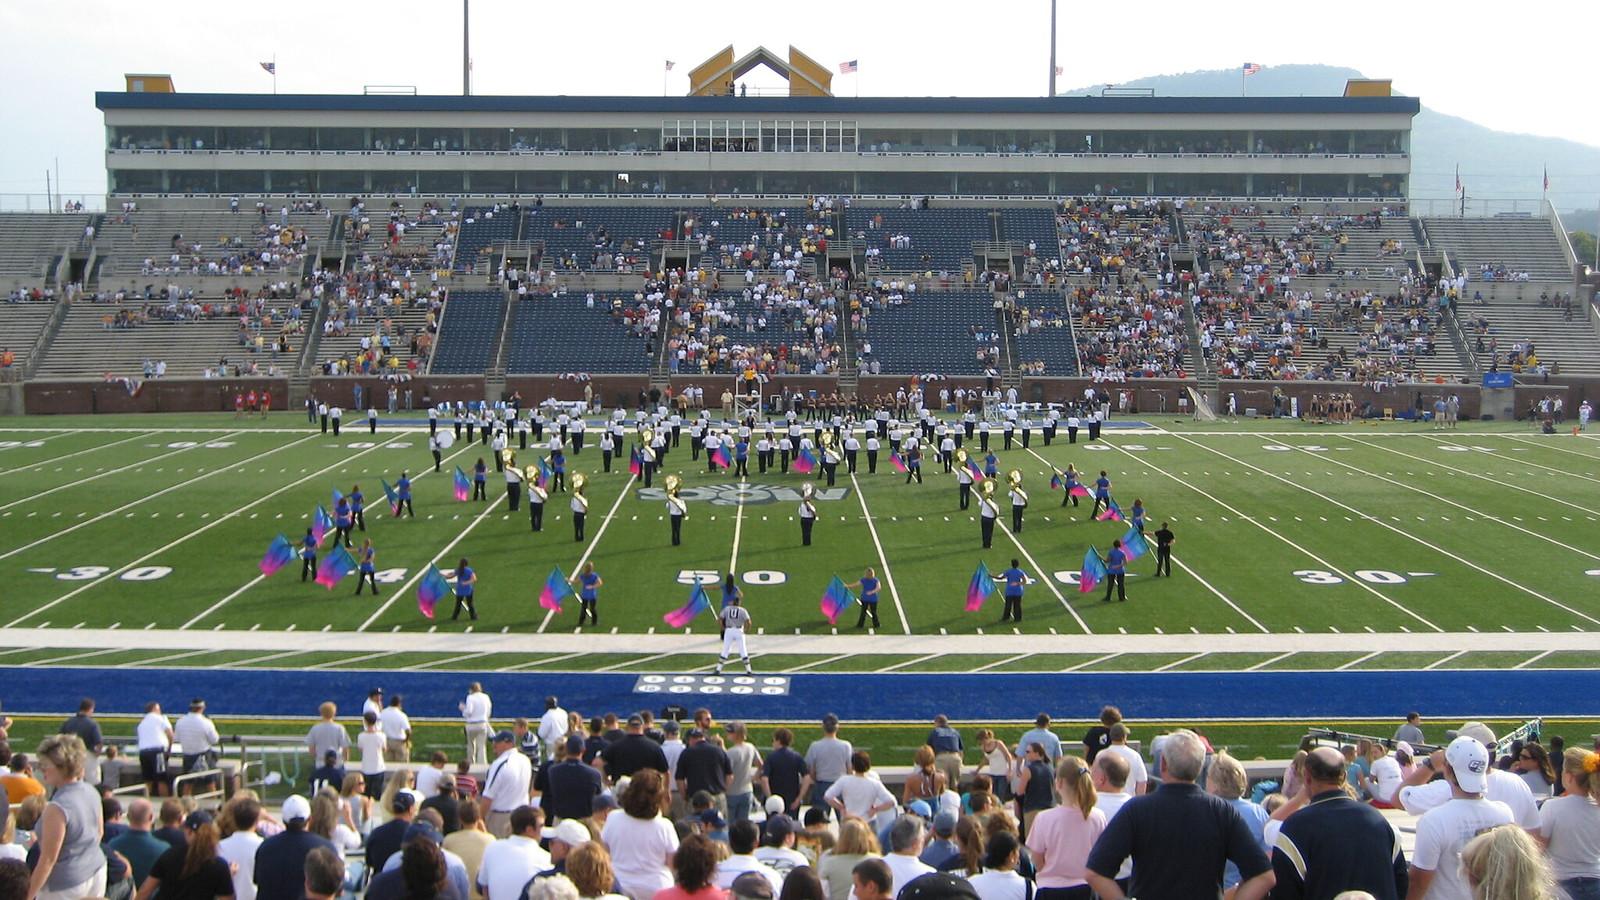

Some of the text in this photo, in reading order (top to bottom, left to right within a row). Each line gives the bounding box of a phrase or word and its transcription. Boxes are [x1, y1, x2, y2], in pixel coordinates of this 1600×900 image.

[55, 566, 173, 580] 30
[676, 569, 787, 585] 50
[1292, 570, 1407, 584] 30
